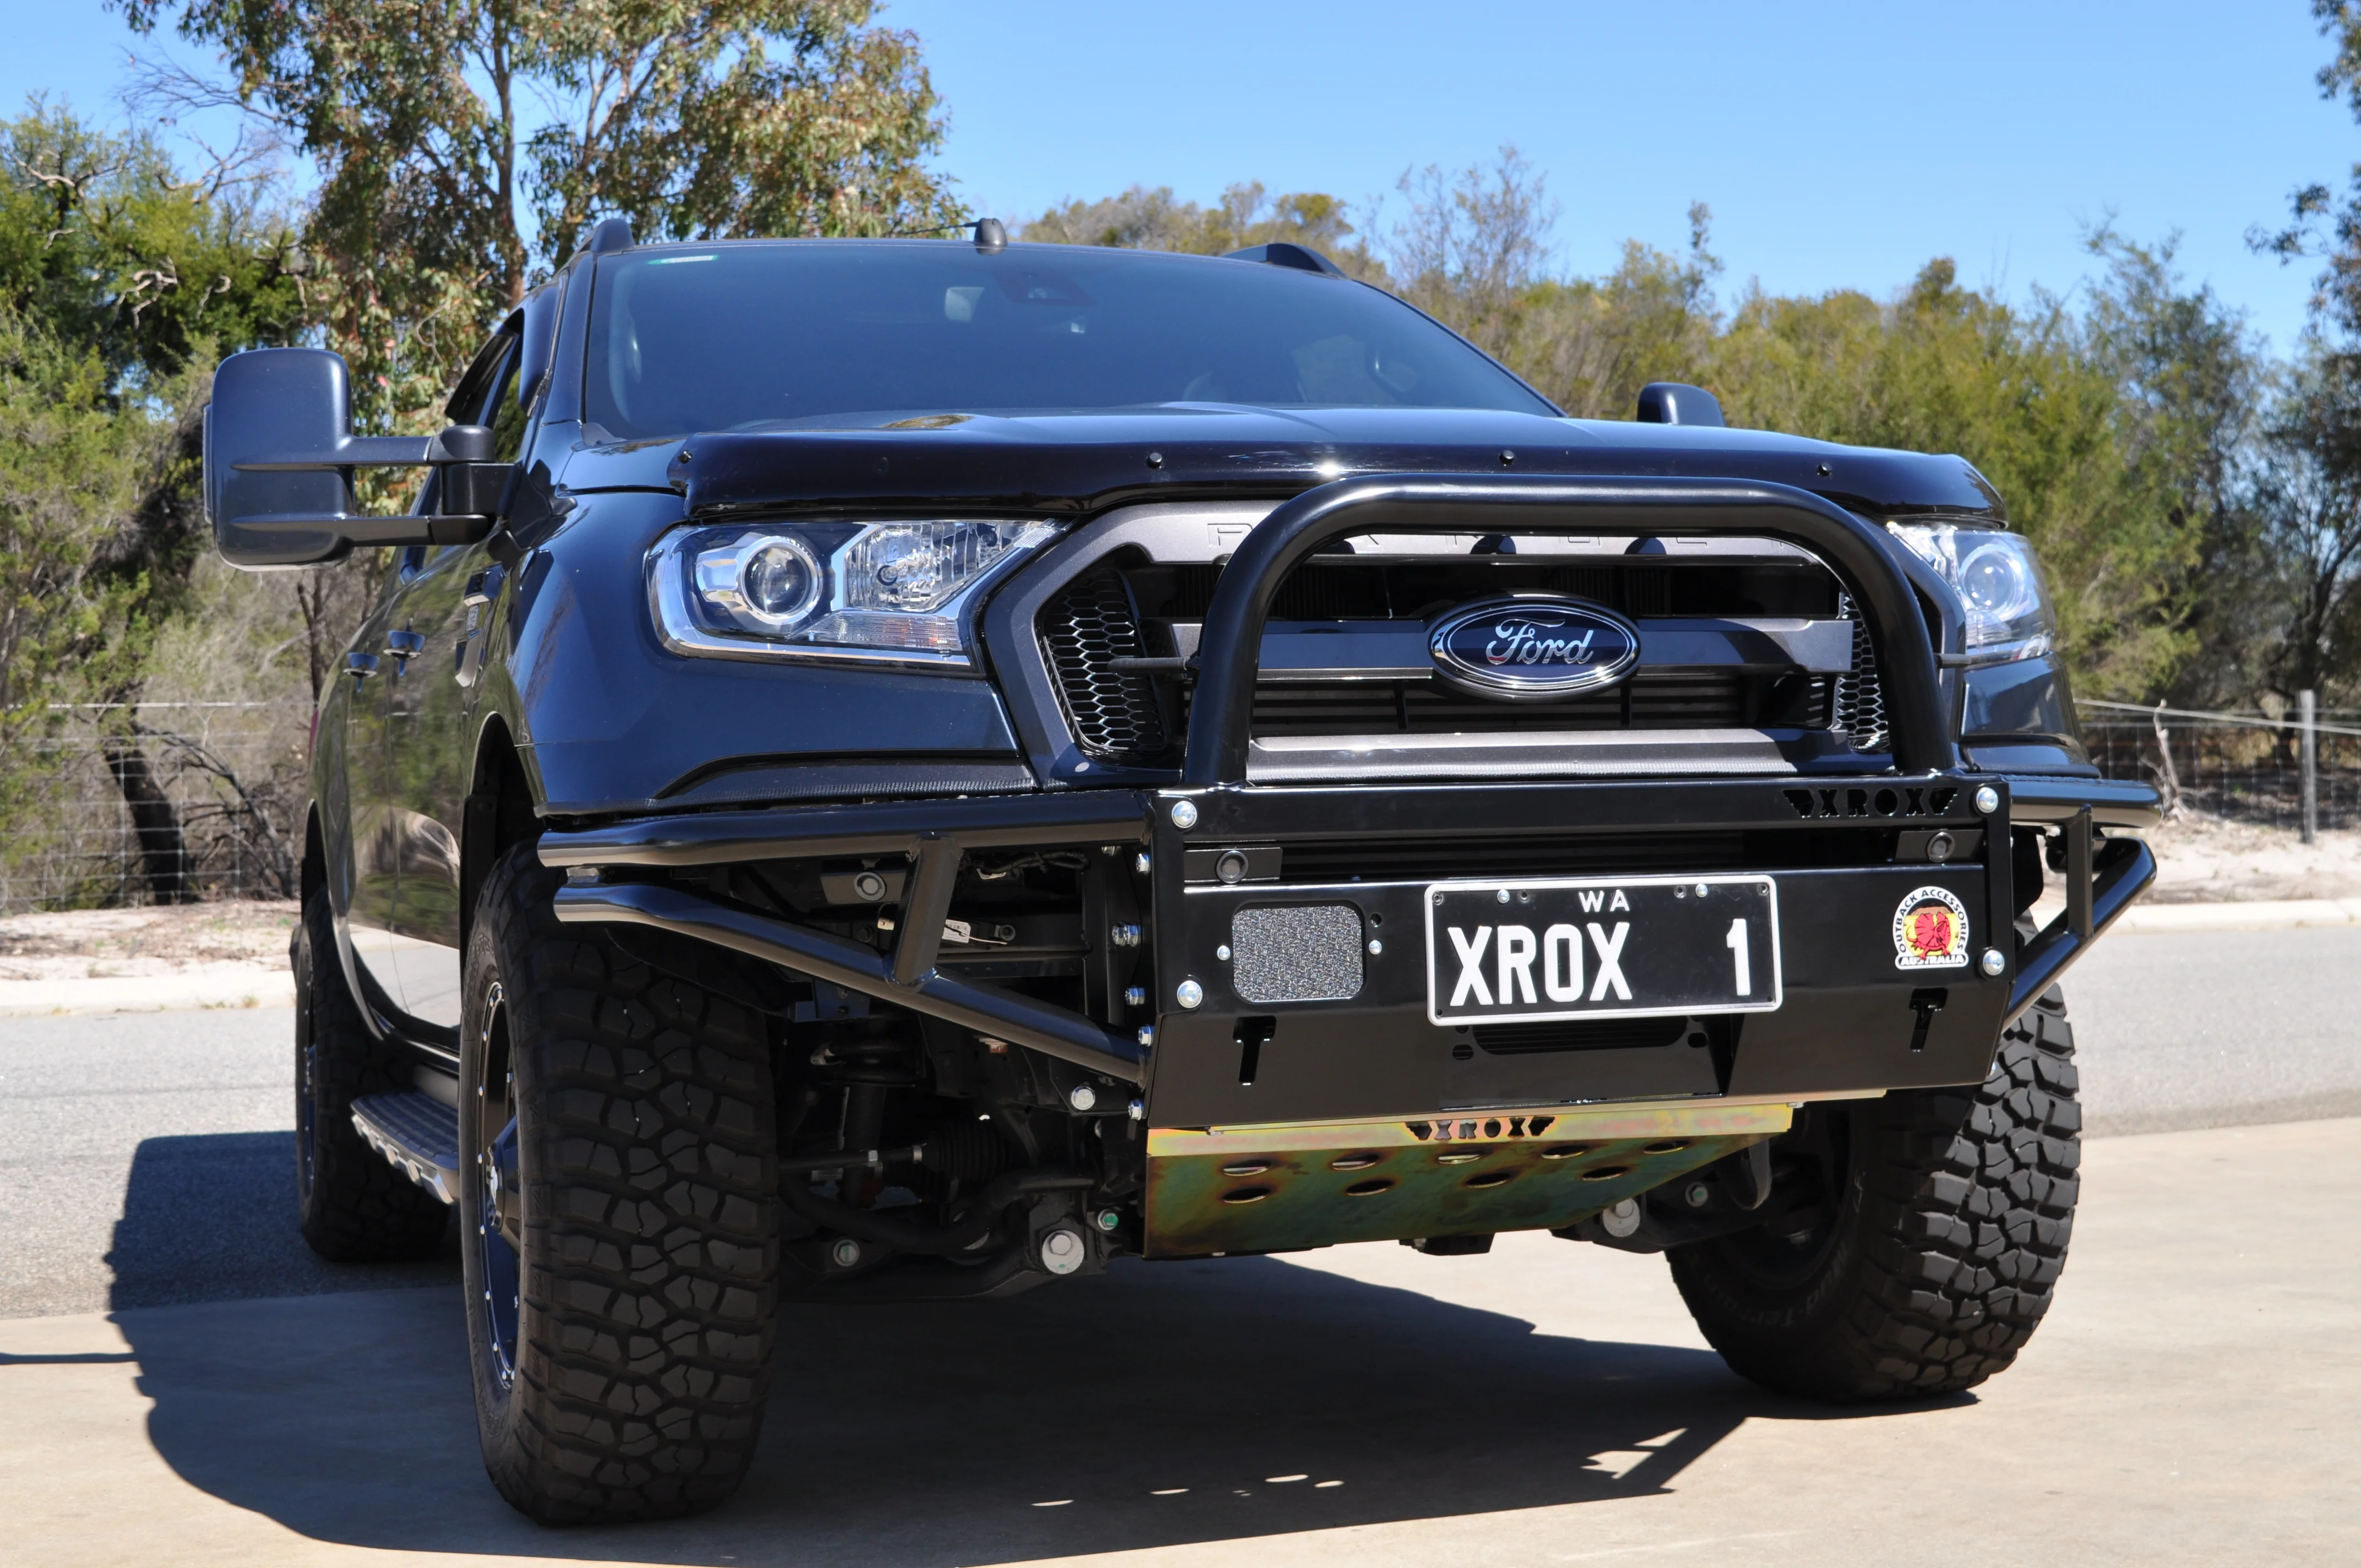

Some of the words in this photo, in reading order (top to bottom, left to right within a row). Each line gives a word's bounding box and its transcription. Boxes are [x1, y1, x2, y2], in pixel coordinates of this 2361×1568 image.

[1486, 616, 1595, 665] Ford
[1818, 788, 1926, 818] XROX
[1578, 889, 1630, 913] WA
[1895, 894, 1918, 953] OUTBACK
[1921, 889, 1967, 951] ACCESSORIES
[1447, 922, 1633, 1006] XROX
[1726, 918, 1751, 996] 1
[1434, 1117, 1526, 1141] XROX
